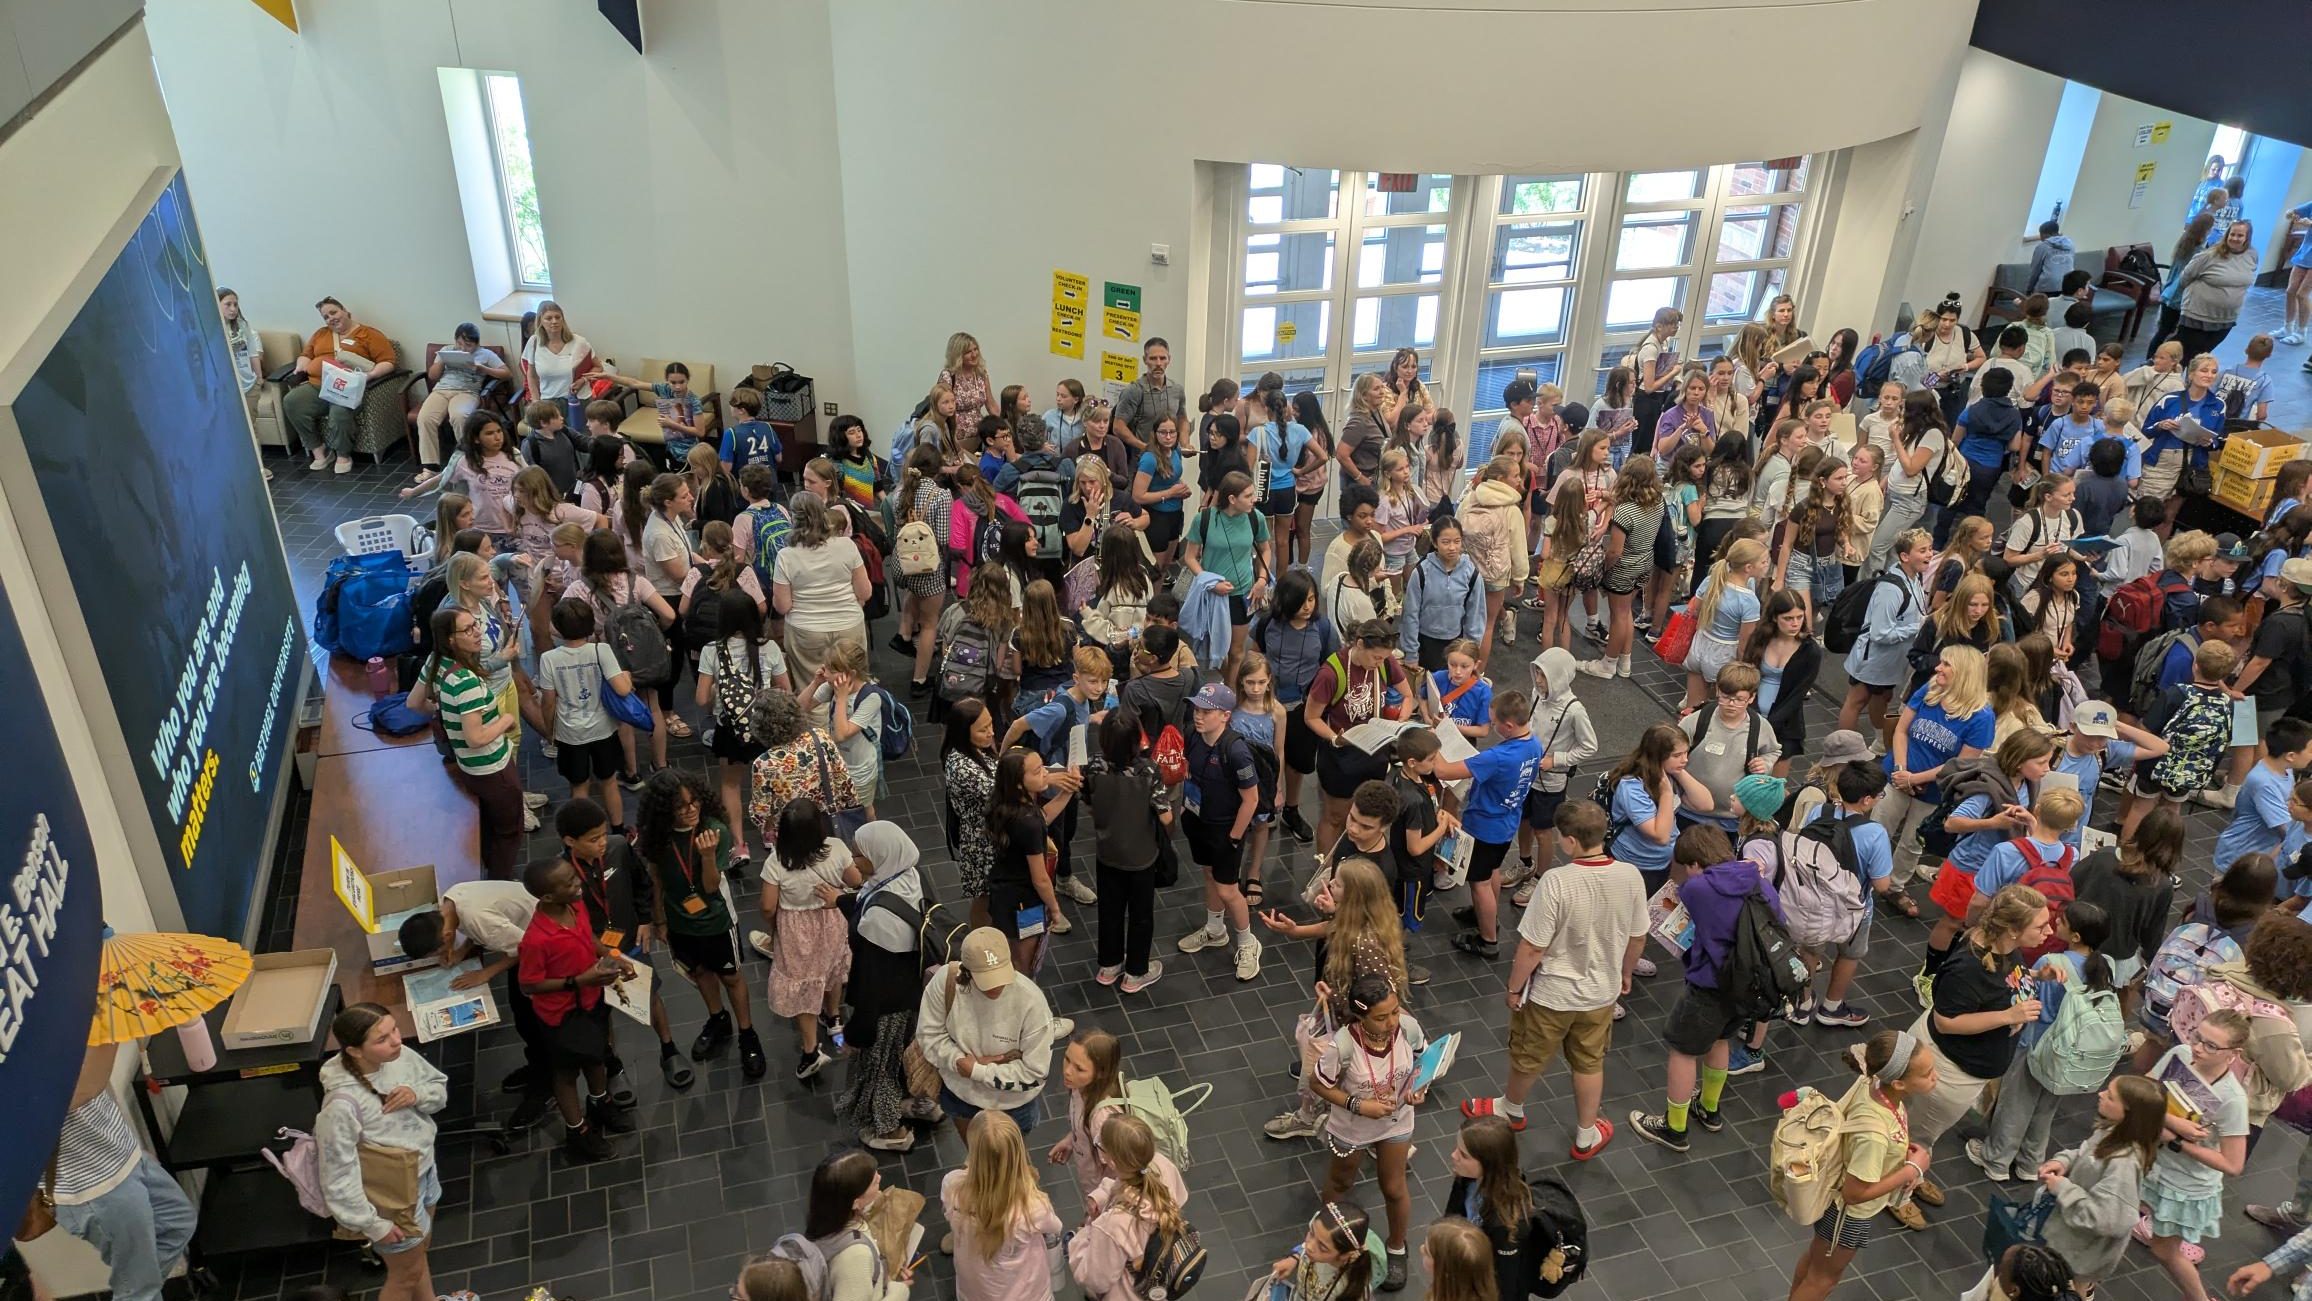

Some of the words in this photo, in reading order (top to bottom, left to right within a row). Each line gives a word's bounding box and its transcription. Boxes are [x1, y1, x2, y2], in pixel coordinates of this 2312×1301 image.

[1055, 274, 1086, 286] VOLUNTEER
[1058, 281, 1083, 292] CHECK-IN
[1111, 286, 1136, 297] GREEN
[1055, 303, 1084, 316] LUNCH
[1057, 311, 1081, 322] CHECK-IN
[1106, 312, 1137, 323] PRESENTER
[1109, 318, 1134, 328] CHECK-IN
[1052, 327, 1082, 338] RESTROOMS
[1115, 370, 1123, 381] 3
[746, 434, 769, 456] 24
[150, 706, 181, 782] Who
[176, 654, 198, 724] you
[192, 616, 210, 669] are
[206, 565, 225, 630] and
[166, 754, 192, 826] who
[186, 700, 208, 771] you
[202, 660, 220, 713] are
[213, 559, 252, 673] becoming
[254, 704, 276, 774] BETHEL
[270, 615, 296, 708] UNIVERSITY
[1912, 731, 1946, 753] SKIPPERS
[180, 747, 221, 870] matters.
[13, 812, 51, 913] Benson
[29, 841, 69, 958] HALL
[984, 950, 999, 967] LA
